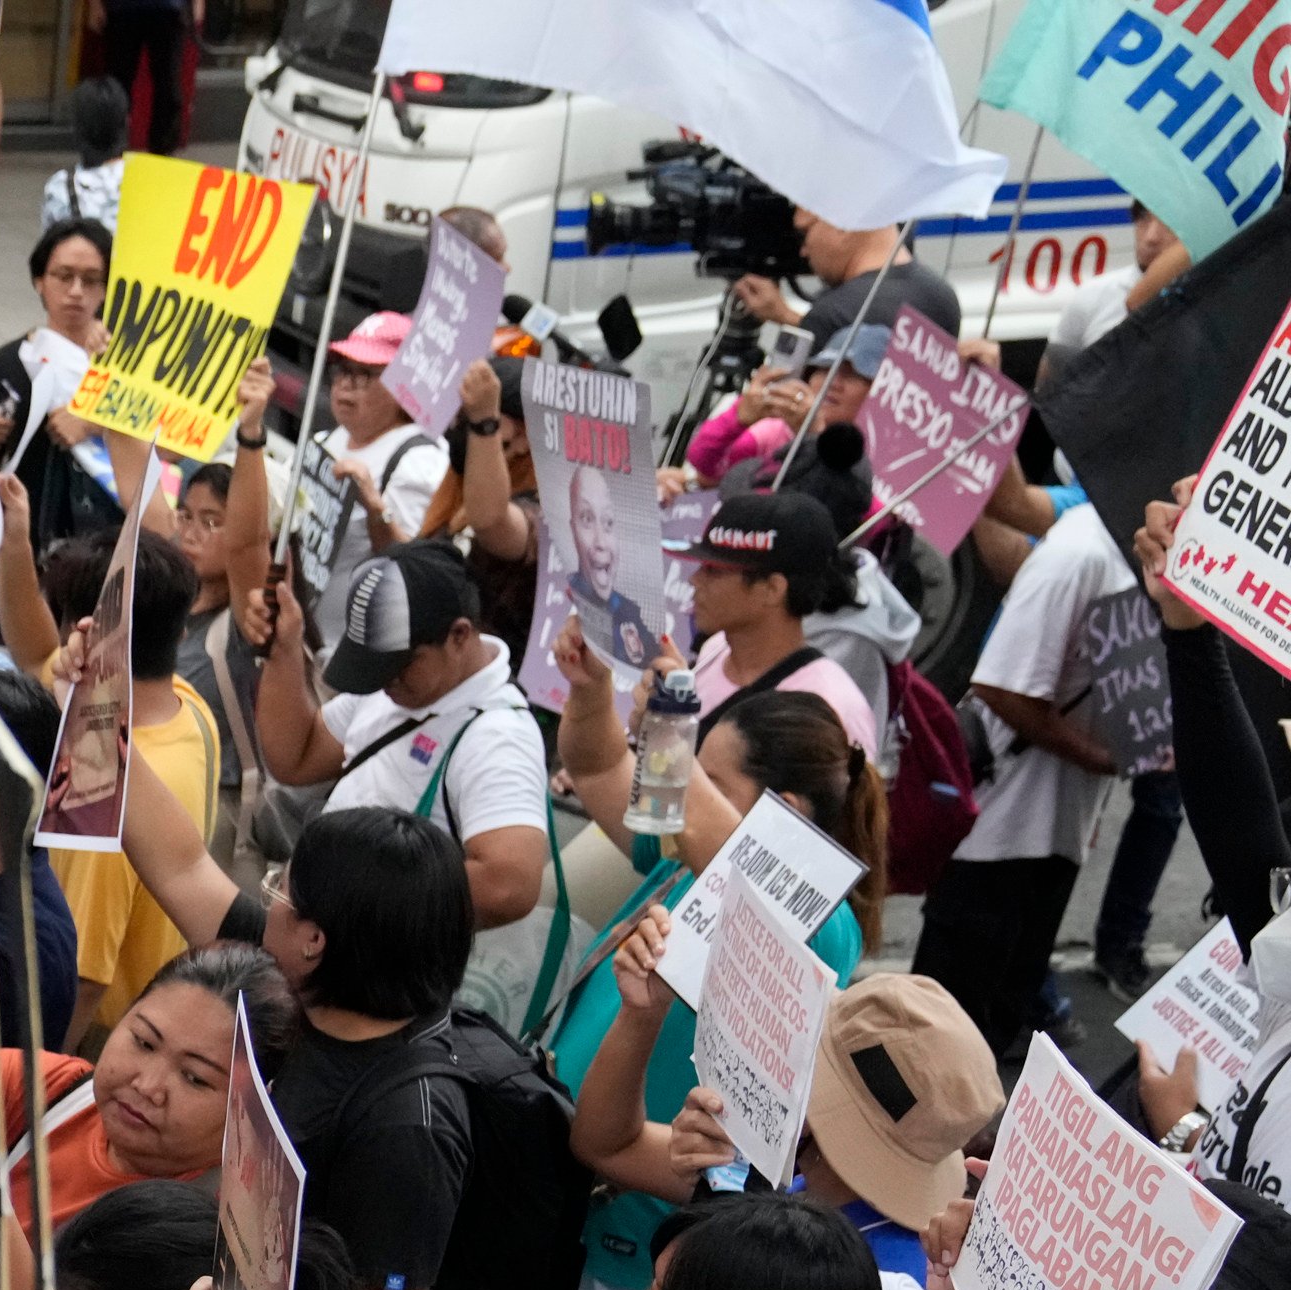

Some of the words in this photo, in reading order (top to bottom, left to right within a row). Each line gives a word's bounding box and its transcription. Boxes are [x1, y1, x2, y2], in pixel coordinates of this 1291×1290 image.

[174, 165, 283, 290] END
[531, 361, 637, 426] ARESTUHIN
[869, 356, 954, 449] PRESYO
[544, 411, 559, 452] SI
[564, 414, 633, 475] BATO!
[1222, 412, 1288, 476] AND
[1189, 576, 1221, 601] HEALTH
[1220, 597, 1261, 630] ALLIANCE
[1260, 624, 1279, 643] FOR
[1236, 569, 1291, 633] HE
[681, 897, 711, 936] End
[727, 834, 779, 887] REJOIN
[763, 862, 797, 902] ICC
[782, 881, 831, 929] NOW!
[719, 908, 750, 969] VICTIMS
[745, 953, 762, 980] OF
[731, 894, 767, 949] JUSTICE
[765, 930, 790, 970] FOR
[782, 959, 805, 995] ALL
[717, 945, 750, 1008] DUTERTE
[746, 997, 793, 1057] HUMAN
[1151, 995, 1196, 1039] JUSTICE
[1192, 1029, 1202, 1049] 4
[1199, 1035, 1221, 1066] ALL
[725, 1007, 796, 1094] VIOLATIONS!
[1045, 1070, 1093, 1151] ITIGIL
[1094, 1134, 1166, 1205] ANG
[1011, 1082, 1195, 1285] PAMAMASLANG!
